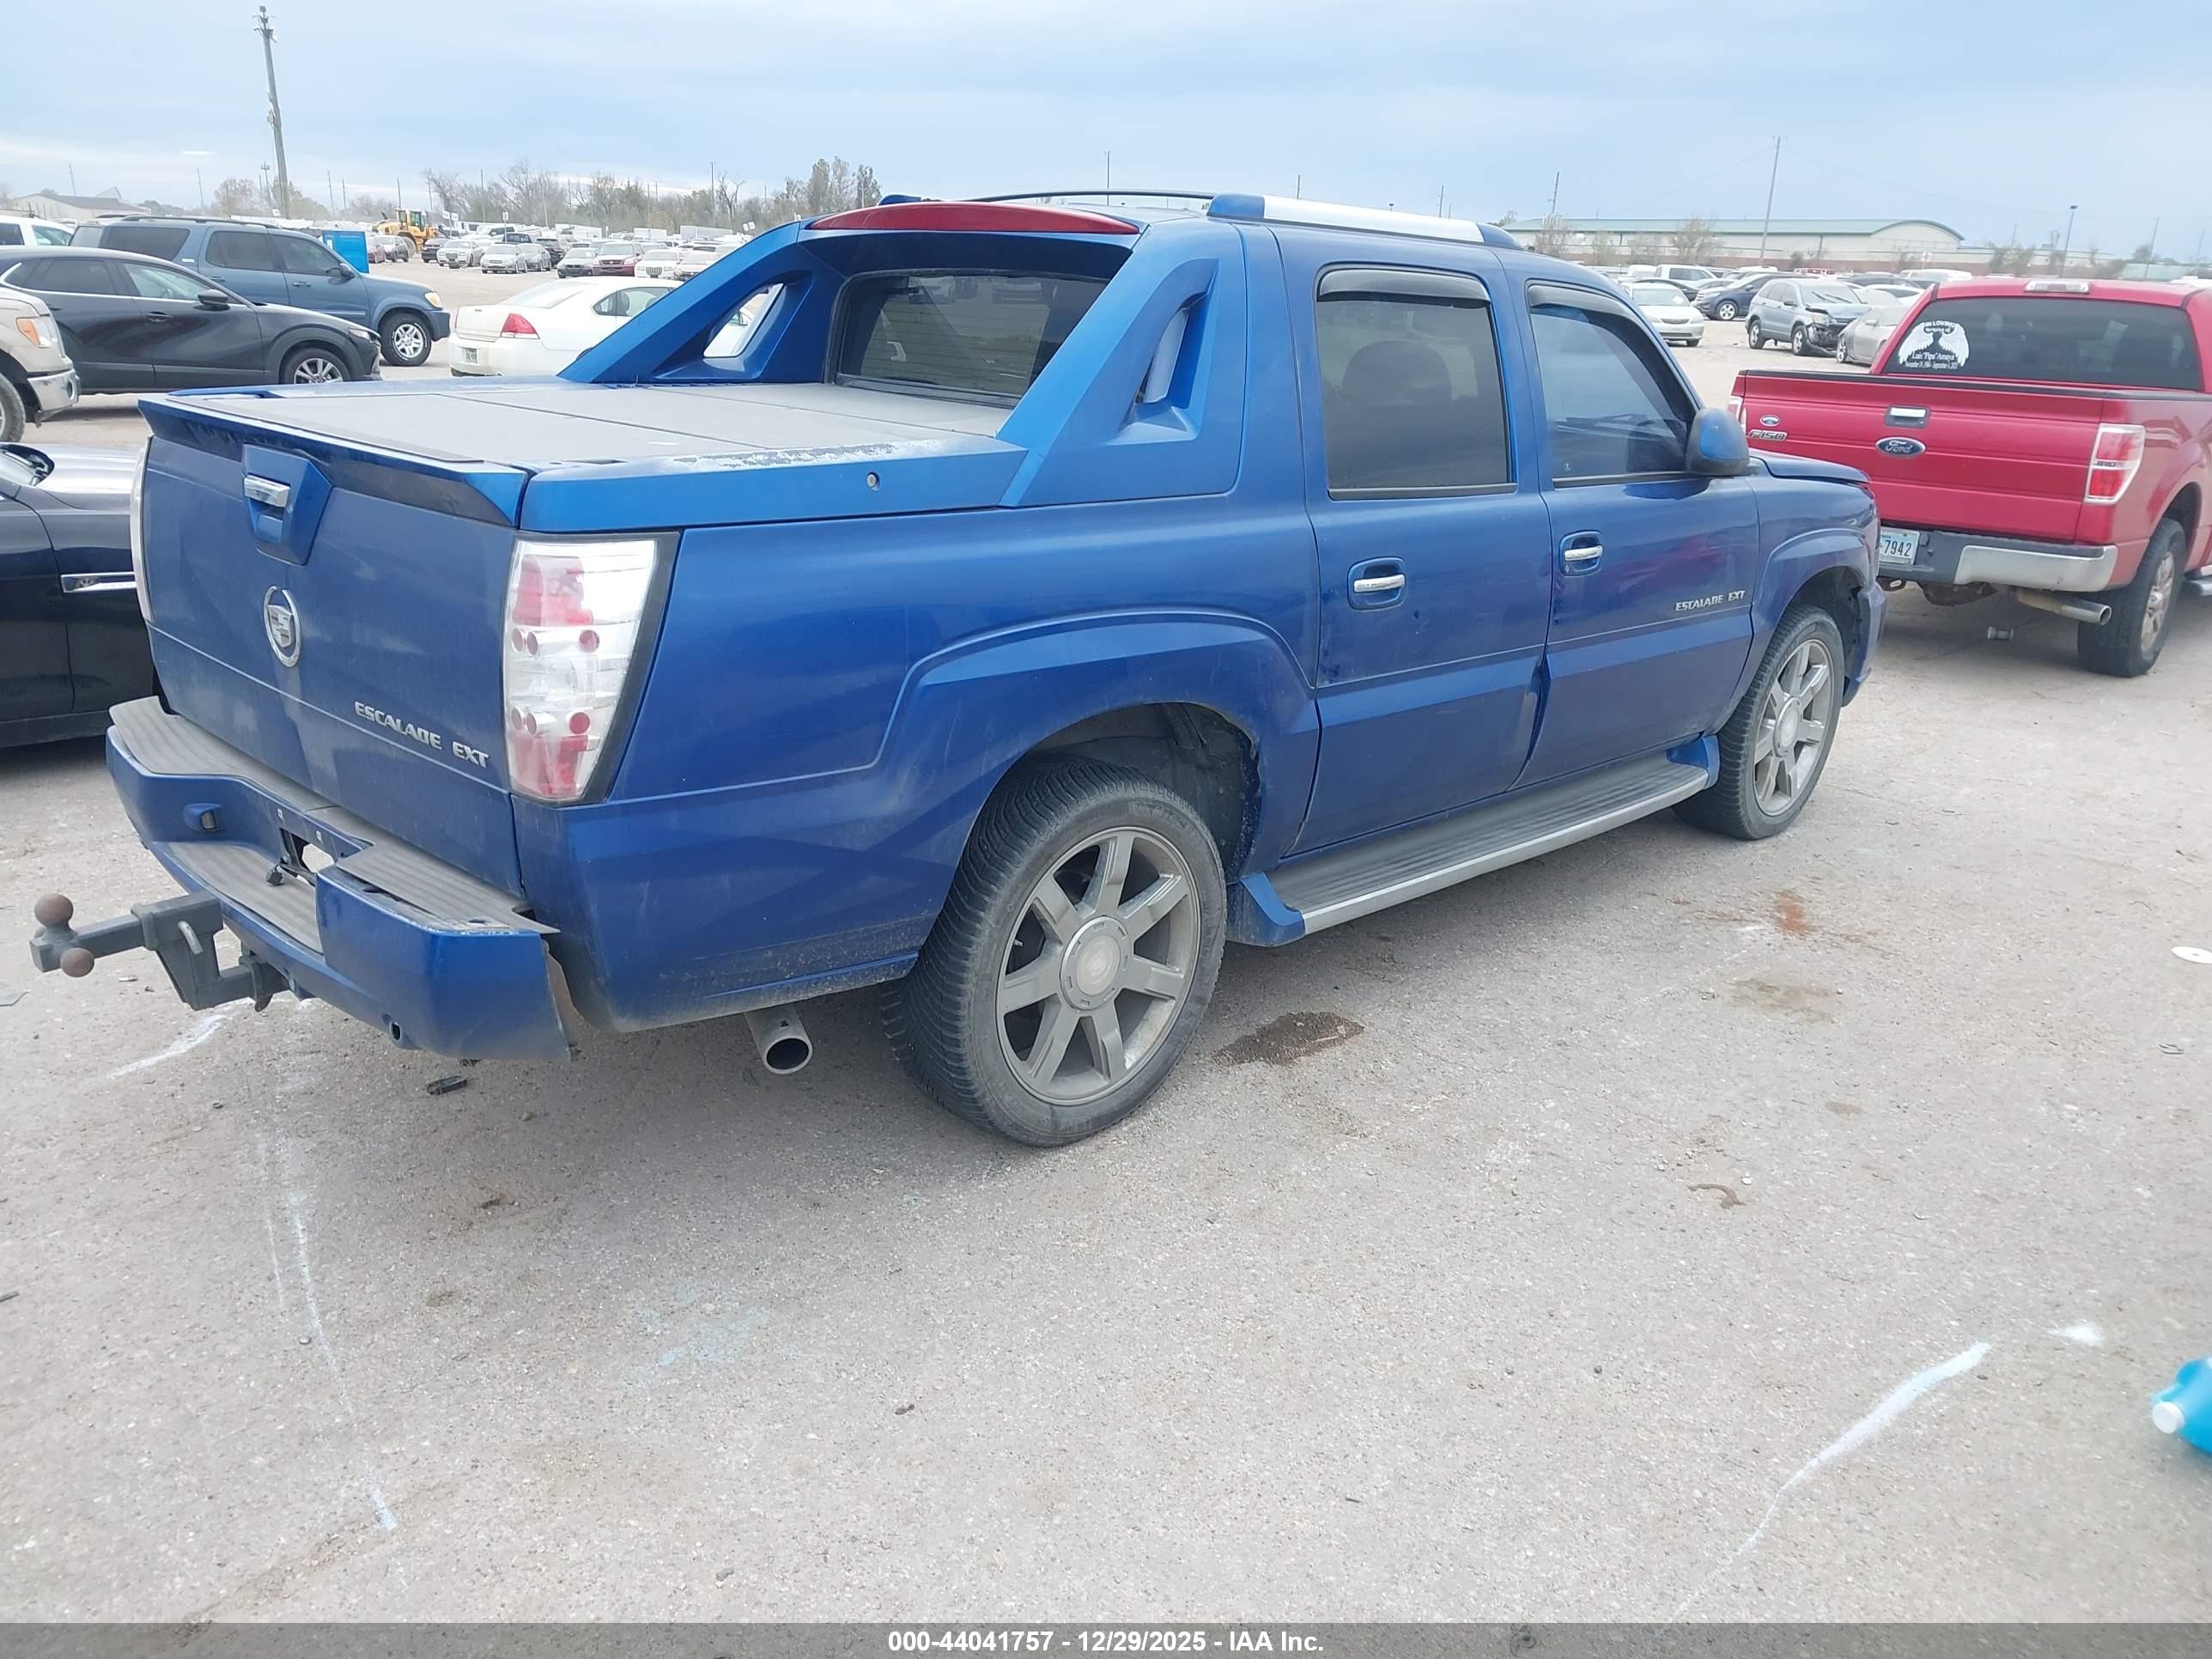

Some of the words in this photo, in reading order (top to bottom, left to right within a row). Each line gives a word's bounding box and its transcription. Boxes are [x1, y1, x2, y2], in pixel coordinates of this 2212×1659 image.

[1885, 441, 1912, 453] Ford
[1884, 539, 1911, 556] 7942
[1675, 595, 1723, 611] ESCALADE
[1728, 591, 1745, 601] EXT
[354, 701, 442, 750] ESCALADE
[452, 741, 490, 769] EXT
